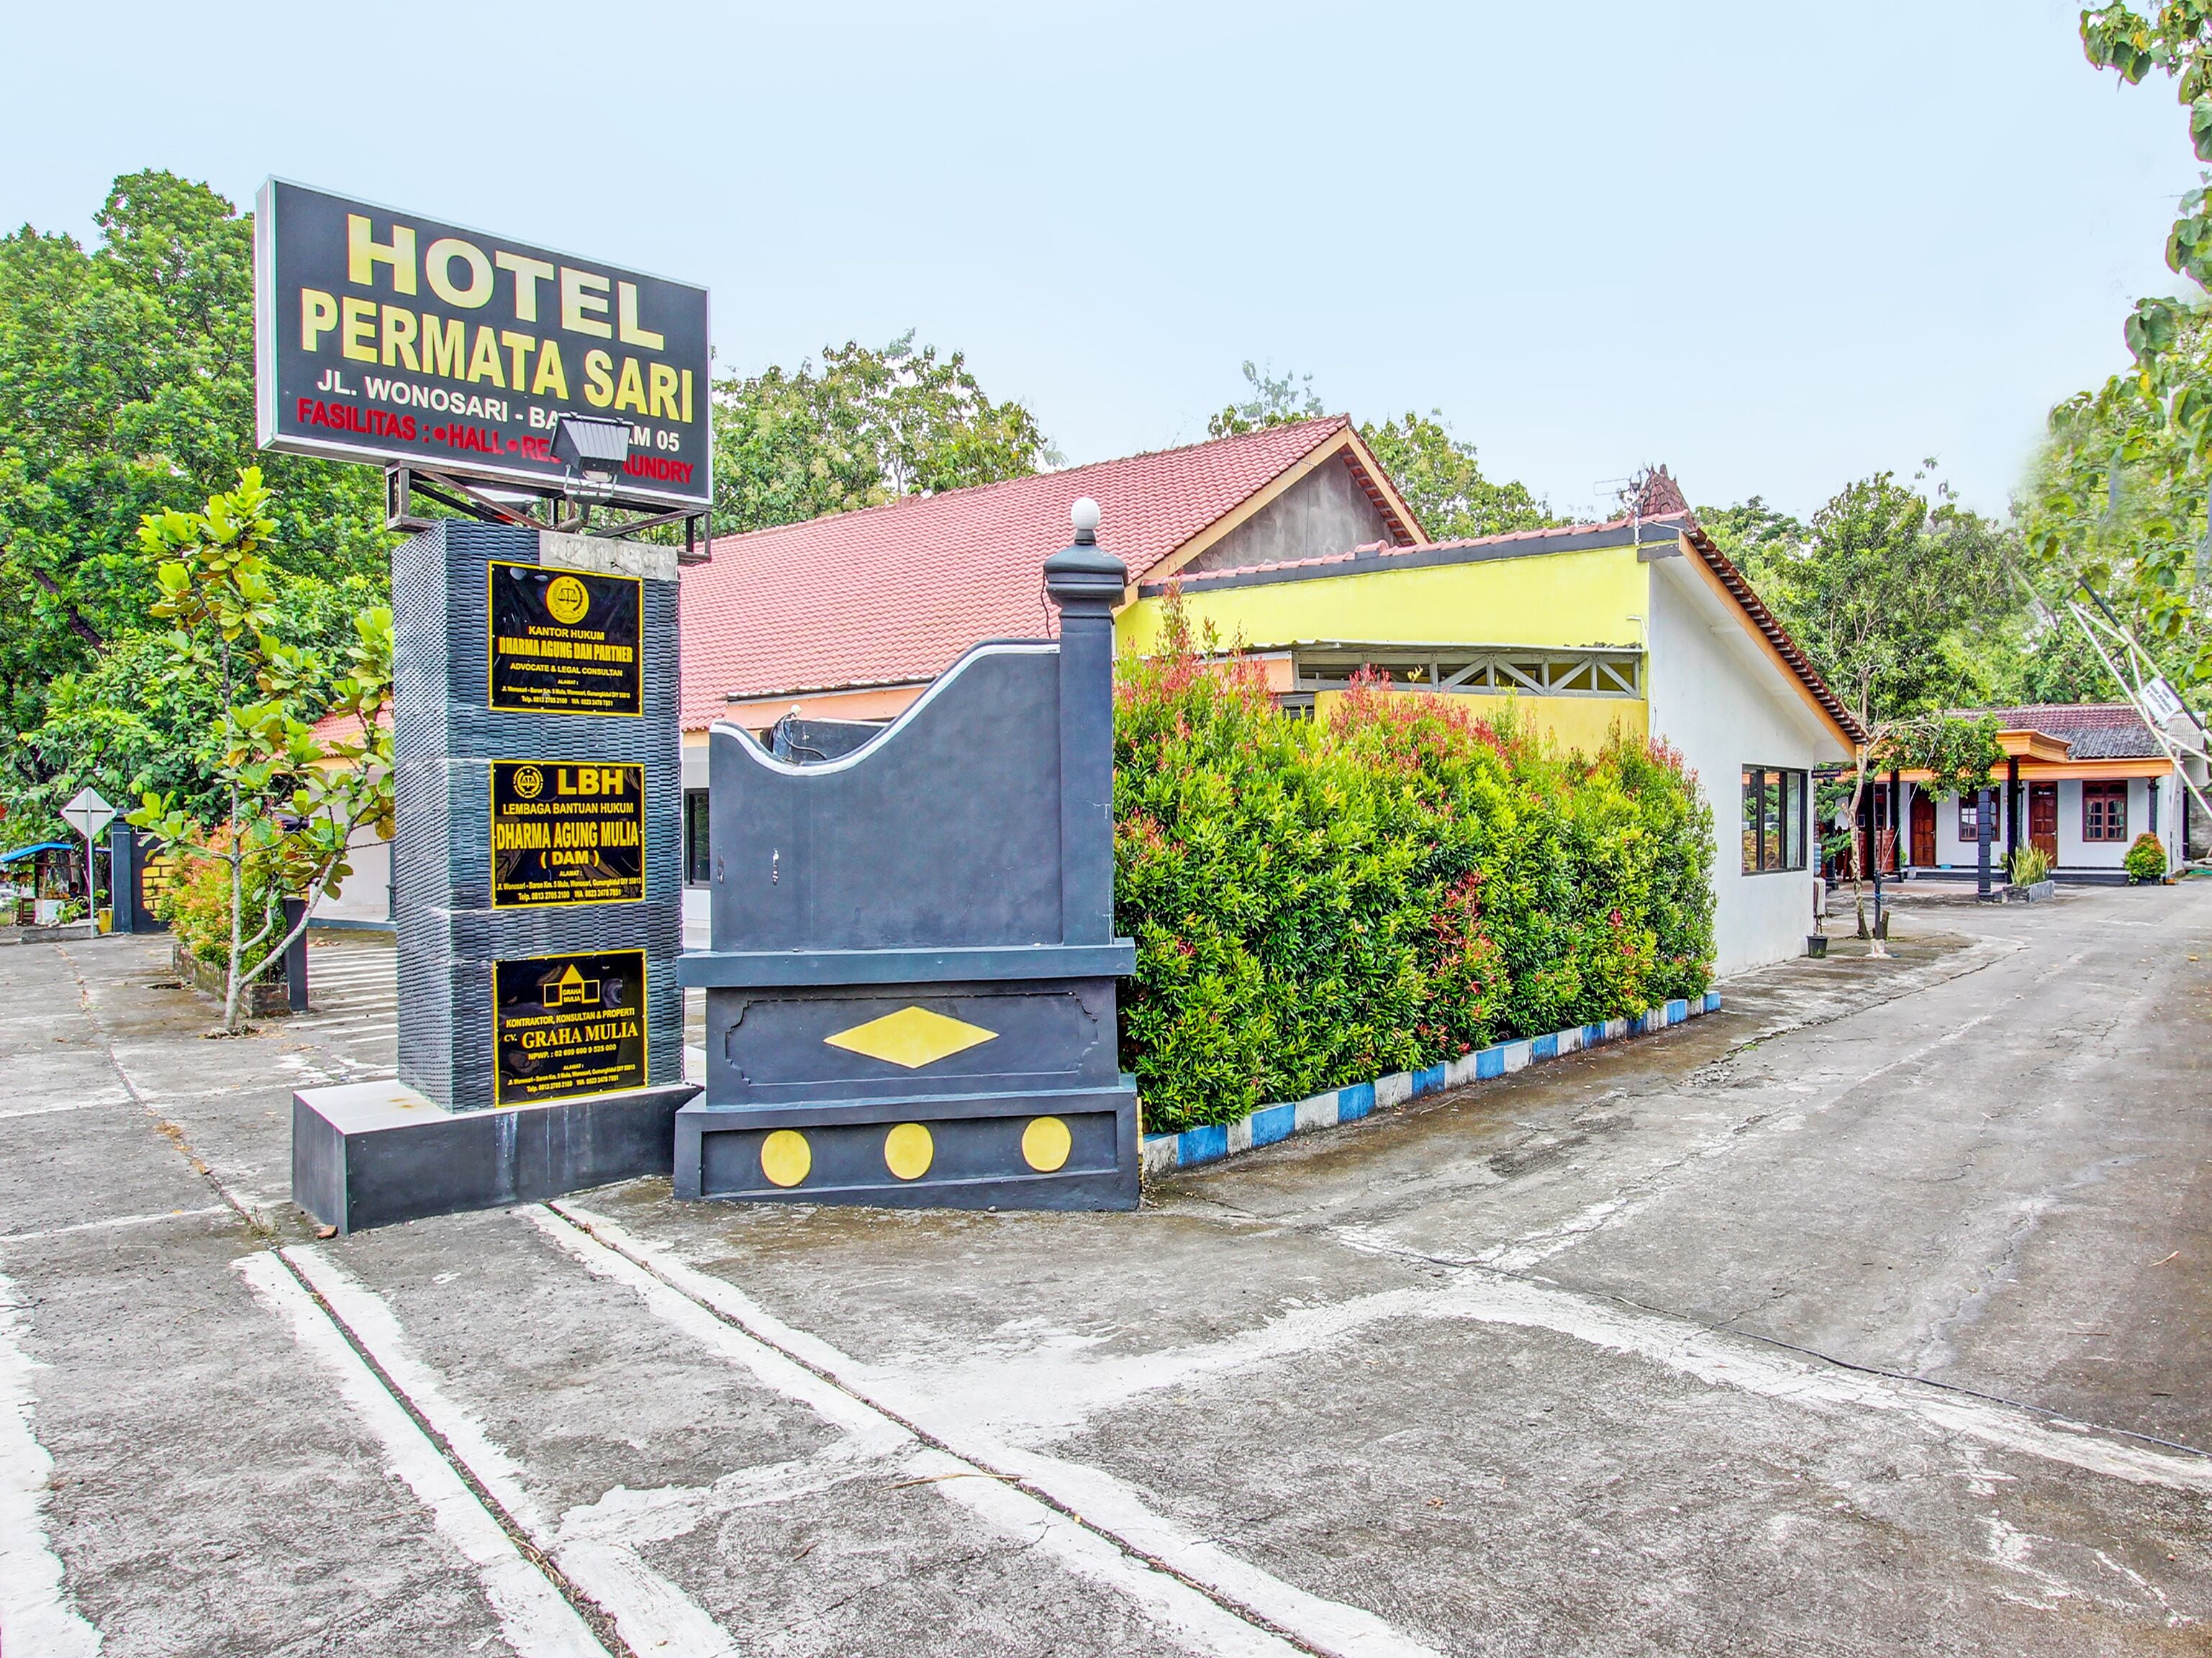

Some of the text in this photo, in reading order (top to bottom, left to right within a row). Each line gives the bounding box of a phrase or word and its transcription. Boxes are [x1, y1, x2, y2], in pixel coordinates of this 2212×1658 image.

[348, 213, 664, 351] HOTEL
[301, 288, 693, 424] PERMATA SARI
[317, 369, 357, 396] JL.
[364, 376, 507, 422] WONOSARI
[656, 429, 680, 452] 05
[297, 398, 416, 441] FASILITAS
[448, 423, 505, 456] HALL
[528, 626, 604, 640] KANTOR HUKUM
[499, 637, 633, 663] DHARMA AGUNG DAN PARTNER
[509, 662, 549, 672] ADVOCATE
[558, 666, 581, 674] LEGAL
[581, 667, 623, 676] CONSULTAN
[558, 769, 624, 795] LBH
[503, 802, 633, 815] LEMBAGA BANTUAN HUKUM
[496, 821, 639, 850] DHARMA AGUNG MULIA
[552, 851, 589, 865] DAM
[504, 882, 525, 890] Wonosari
[592, 878, 620, 887] Gunungkidul
[545, 891, 557, 900] 2705
[558, 890, 570, 899] 2100
[506, 1007, 635, 1028] KONTRAKTOR, KONSULTAN & PROPERTI
[504, 1021, 639, 1049] CV. GRAHA MULIA
